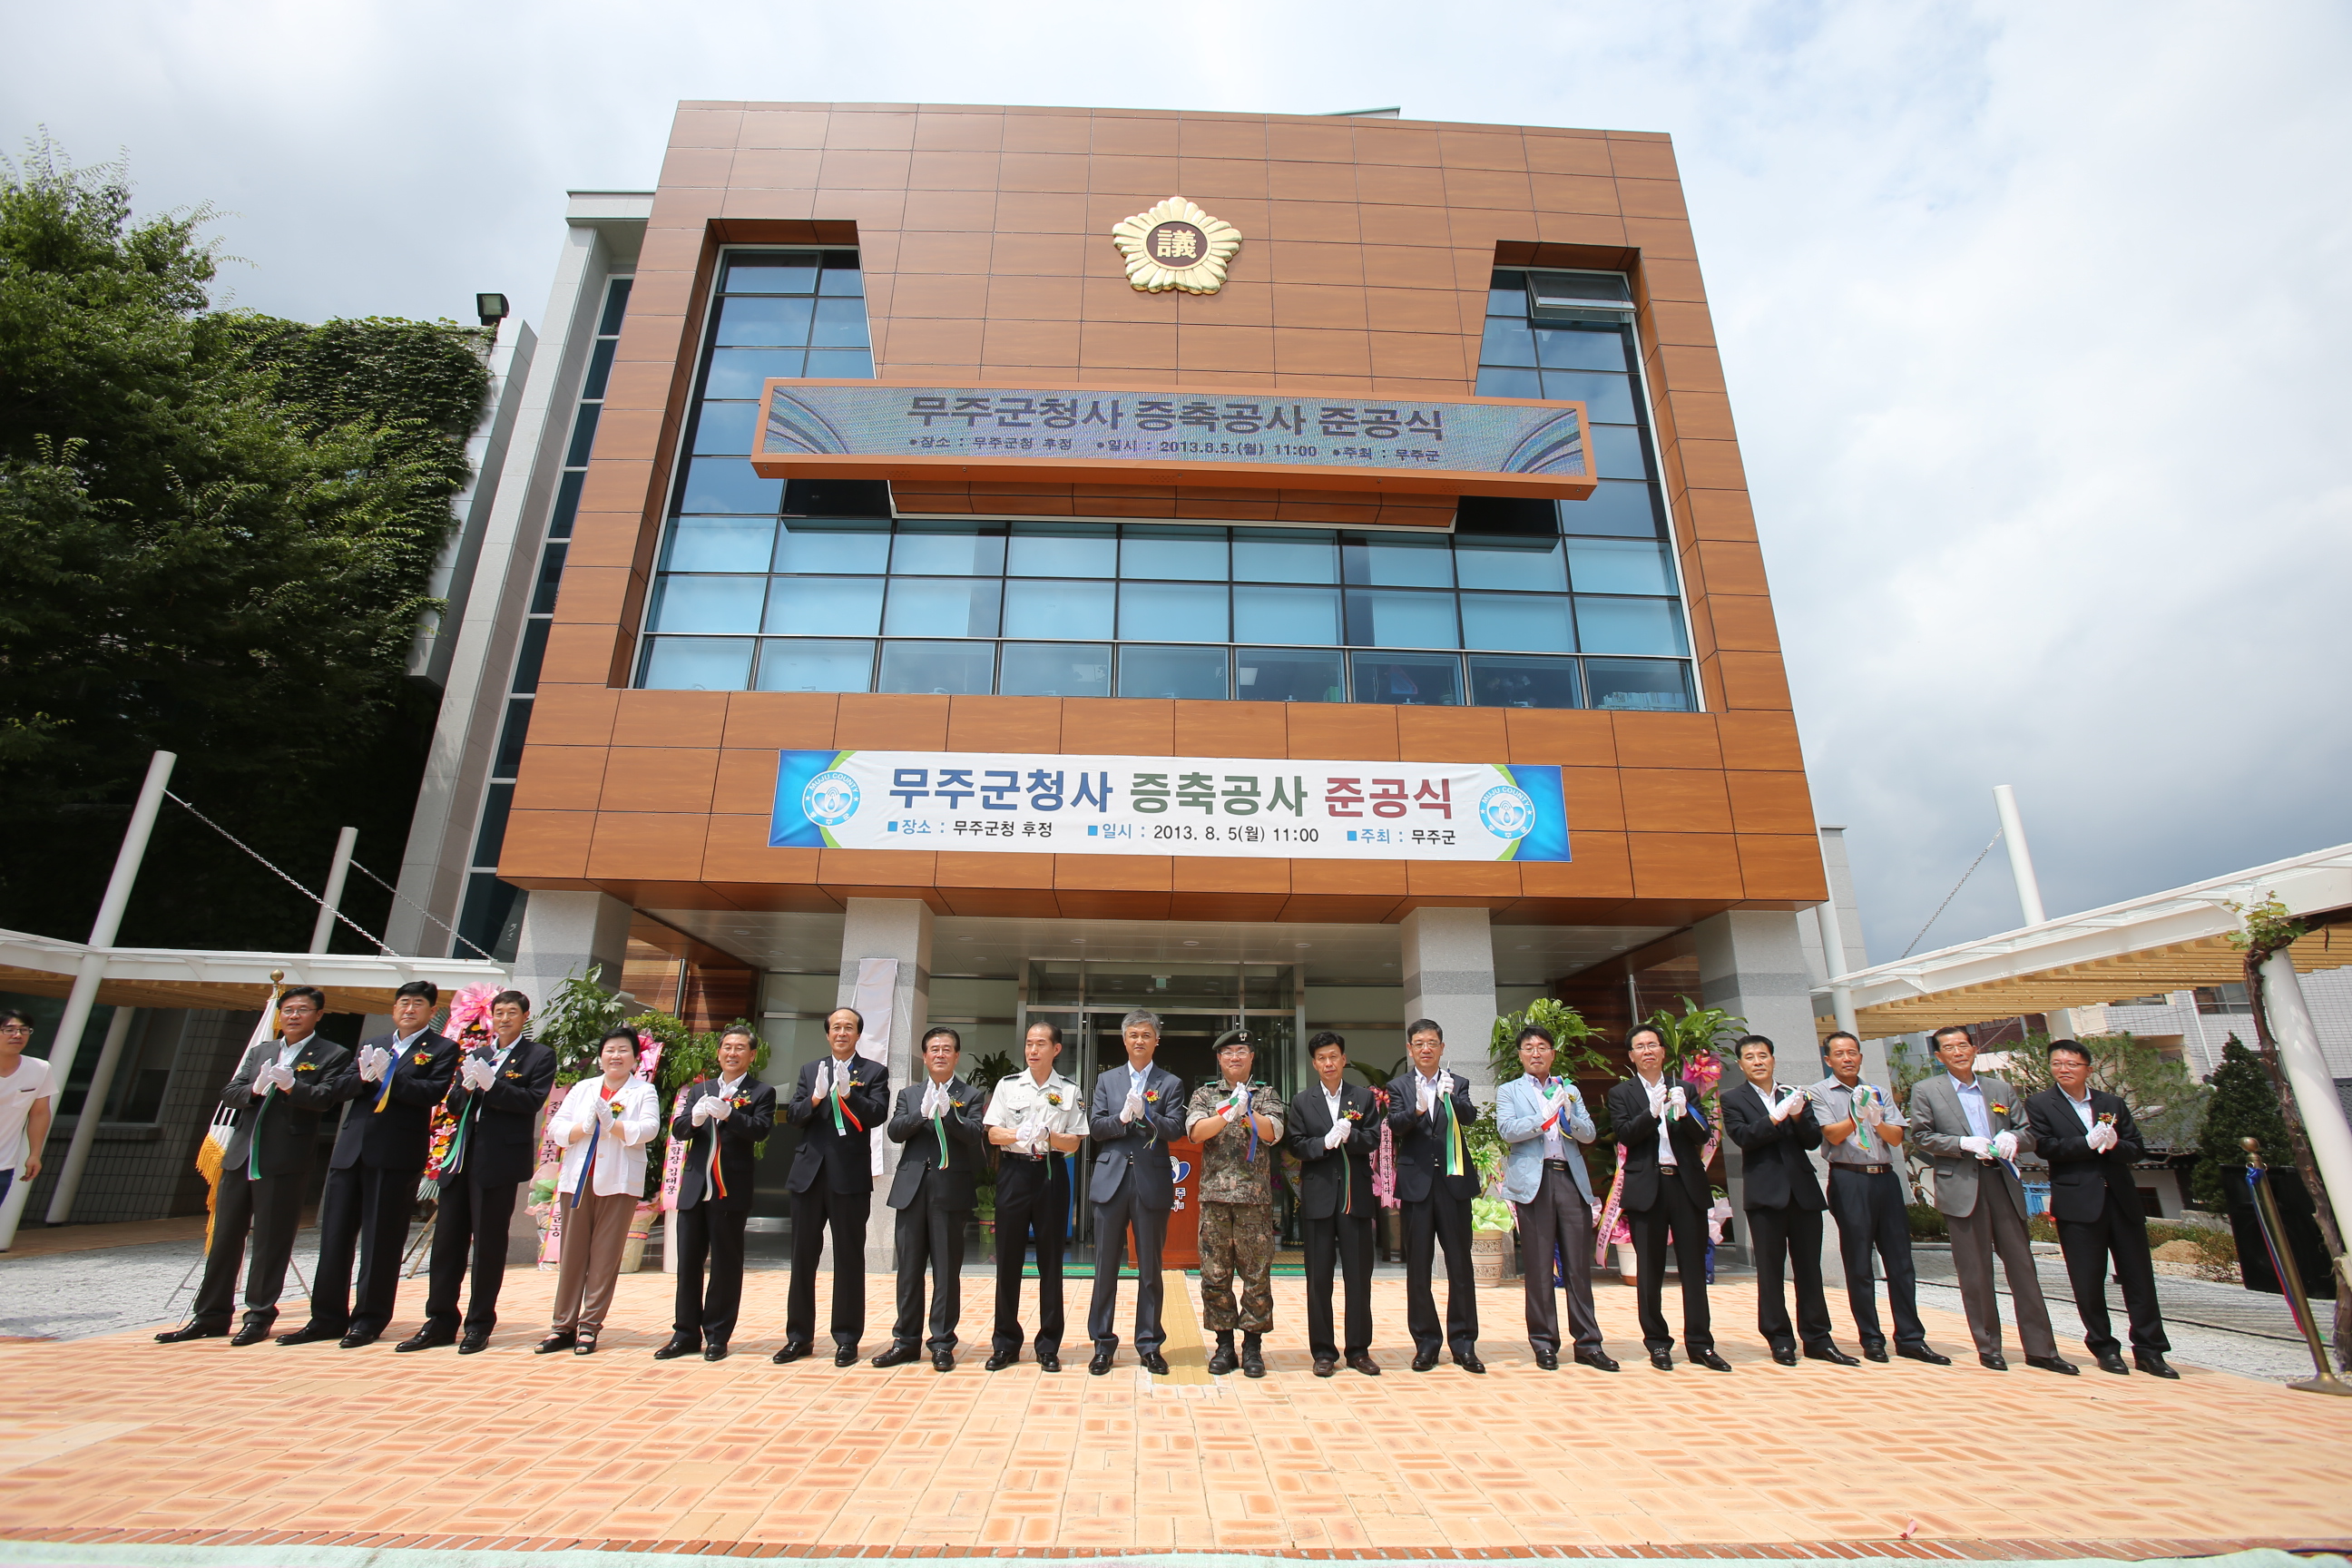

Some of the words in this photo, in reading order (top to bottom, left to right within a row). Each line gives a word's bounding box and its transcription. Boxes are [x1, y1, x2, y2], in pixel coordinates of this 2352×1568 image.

[1157, 230, 1197, 259] 議
[907, 397, 1123, 430] 무주군청사
[1135, 401, 1306, 436] 증축공사
[1318, 407, 1442, 441] 준공식
[921, 436, 950, 448] 장소
[972, 436, 1034, 450] 무주군청
[1043, 438, 1072, 451] 후정
[1108, 439, 1137, 452] 일시
[1273, 444, 1317, 457] 11:00
[1343, 446, 1372, 460] 주최
[1396, 448, 1440, 463] 무주군
[808, 773, 830, 790] MUJU
[832, 772, 859, 793] COUNTY
[889, 769, 1113, 812] 무주군청사
[1130, 771, 1308, 817] 증축공사
[1325, 777, 1452, 819] 준공식
[1481, 787, 1500, 804] MUJU
[1502, 786, 1531, 806] COUNTY
[901, 819, 931, 835] 장소
[953, 820, 1014, 837] 무주군청
[1022, 821, 1053, 838] 후정
[1102, 823, 1132, 838] 일시
[1273, 828, 1318, 842] 11:00
[1361, 828, 1390, 844] 주최
[1411, 829, 1456, 845] 무주군
